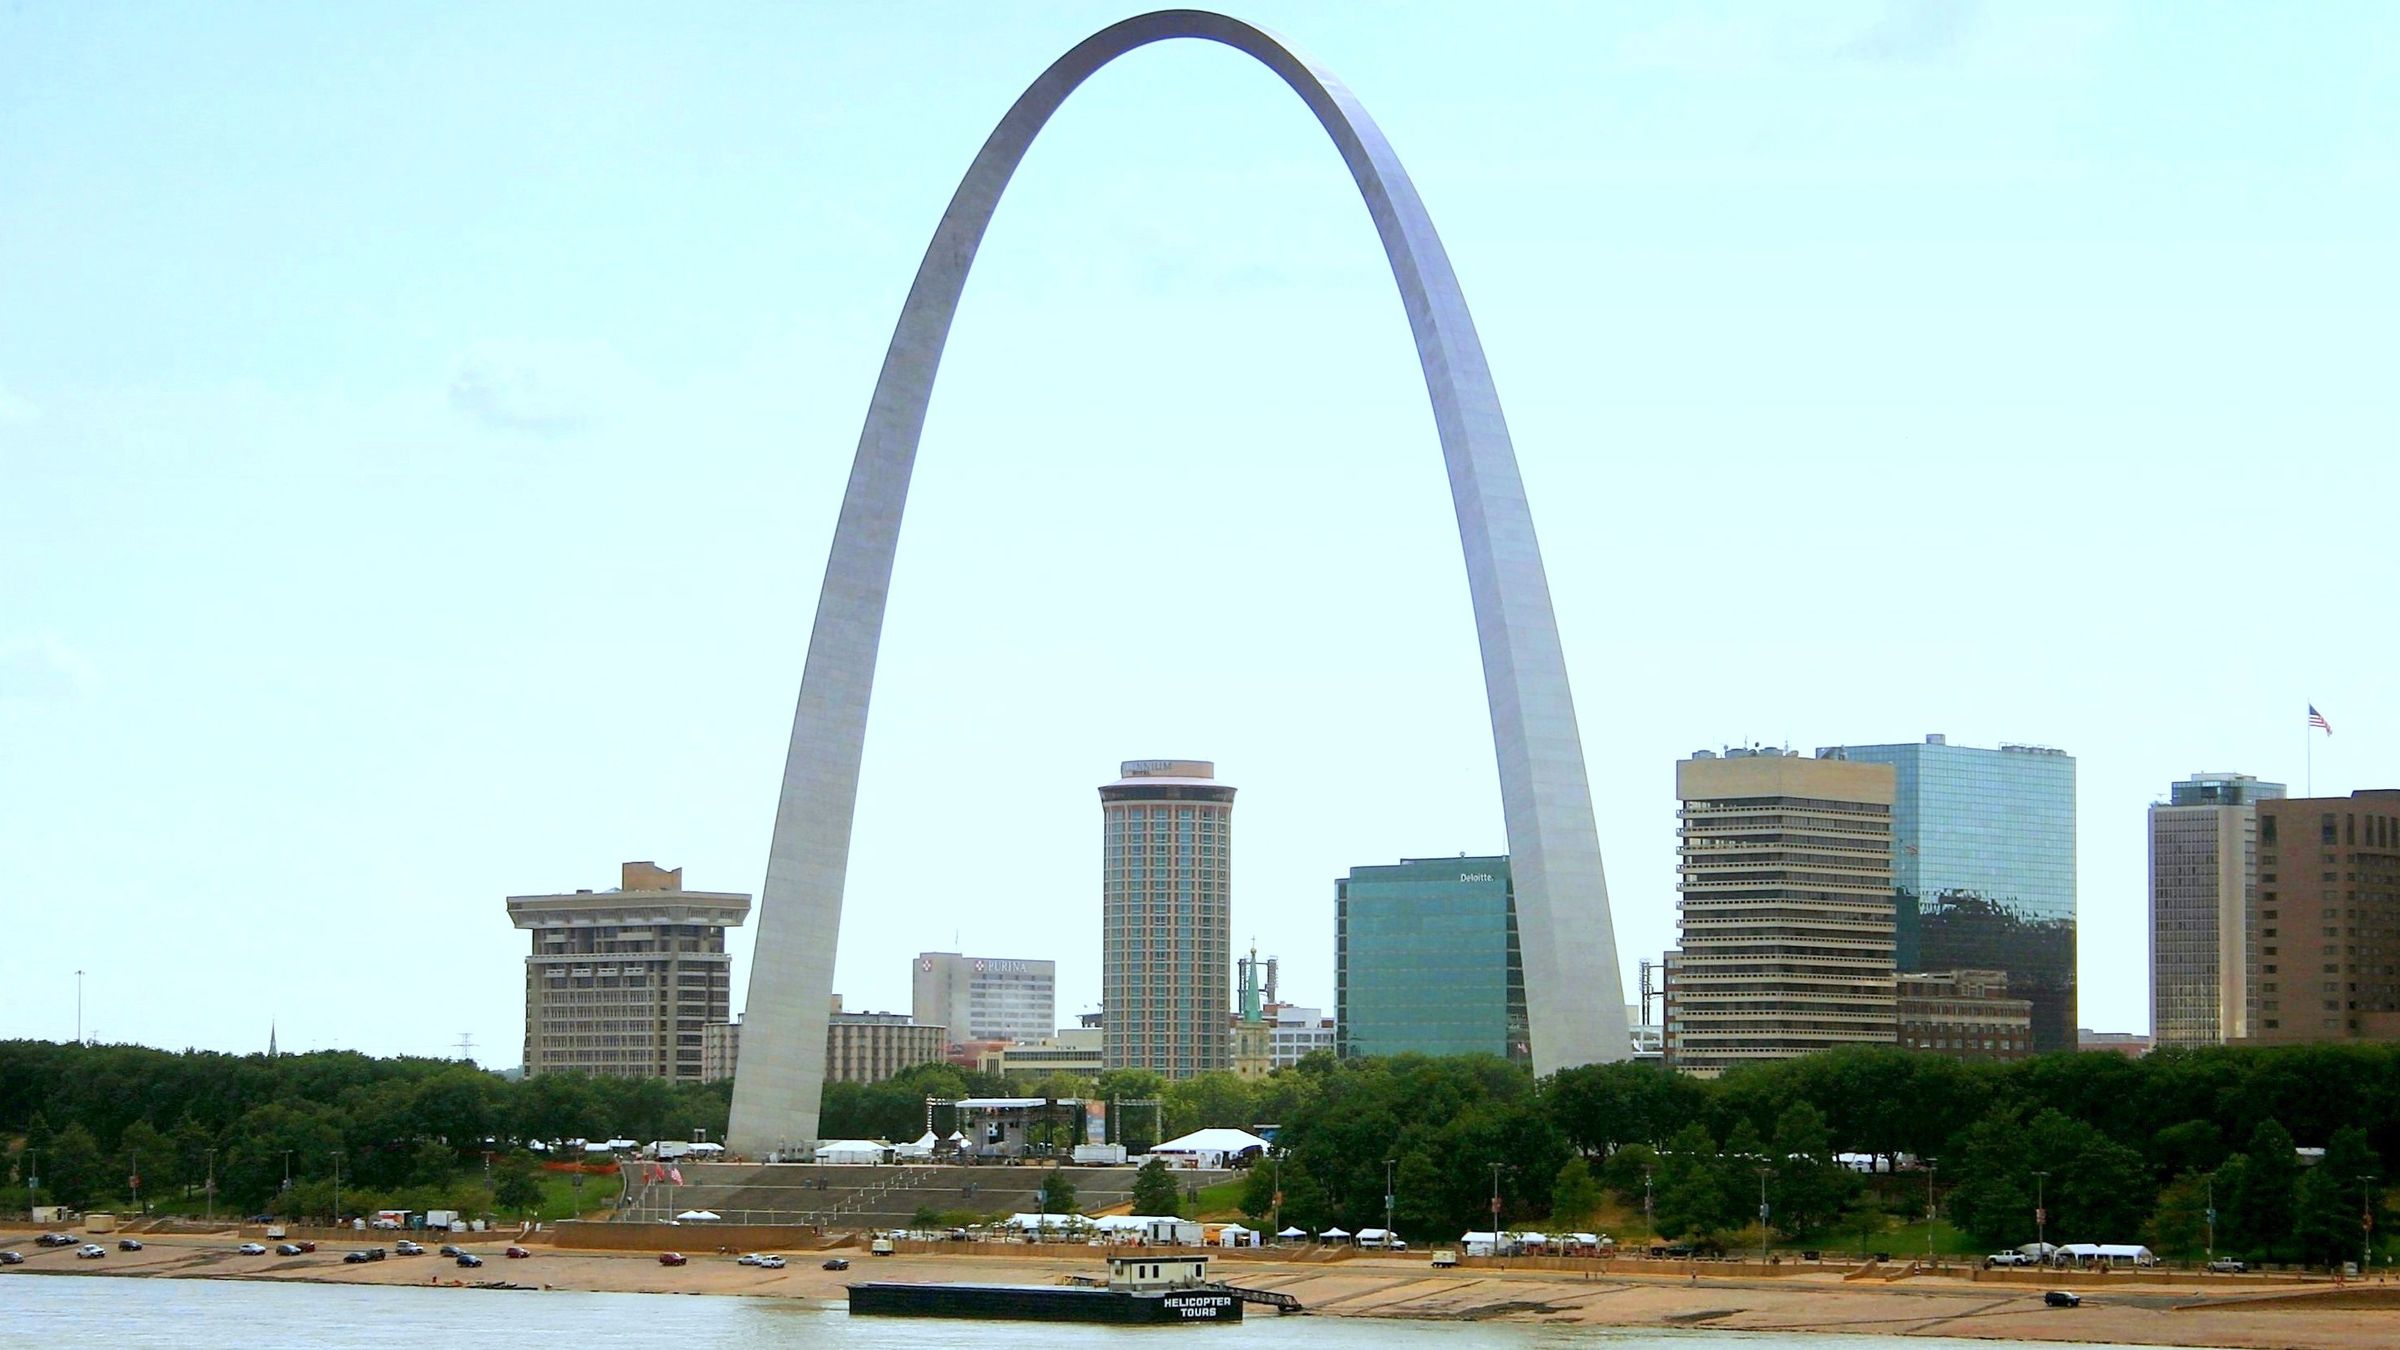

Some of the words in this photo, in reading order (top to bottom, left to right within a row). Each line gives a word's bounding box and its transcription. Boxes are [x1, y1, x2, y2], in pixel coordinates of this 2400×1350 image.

[988, 960, 1027, 972] PURINA
[1164, 1297, 1231, 1308] HELICOPTER
[1180, 1307, 1217, 1317] TOURS
